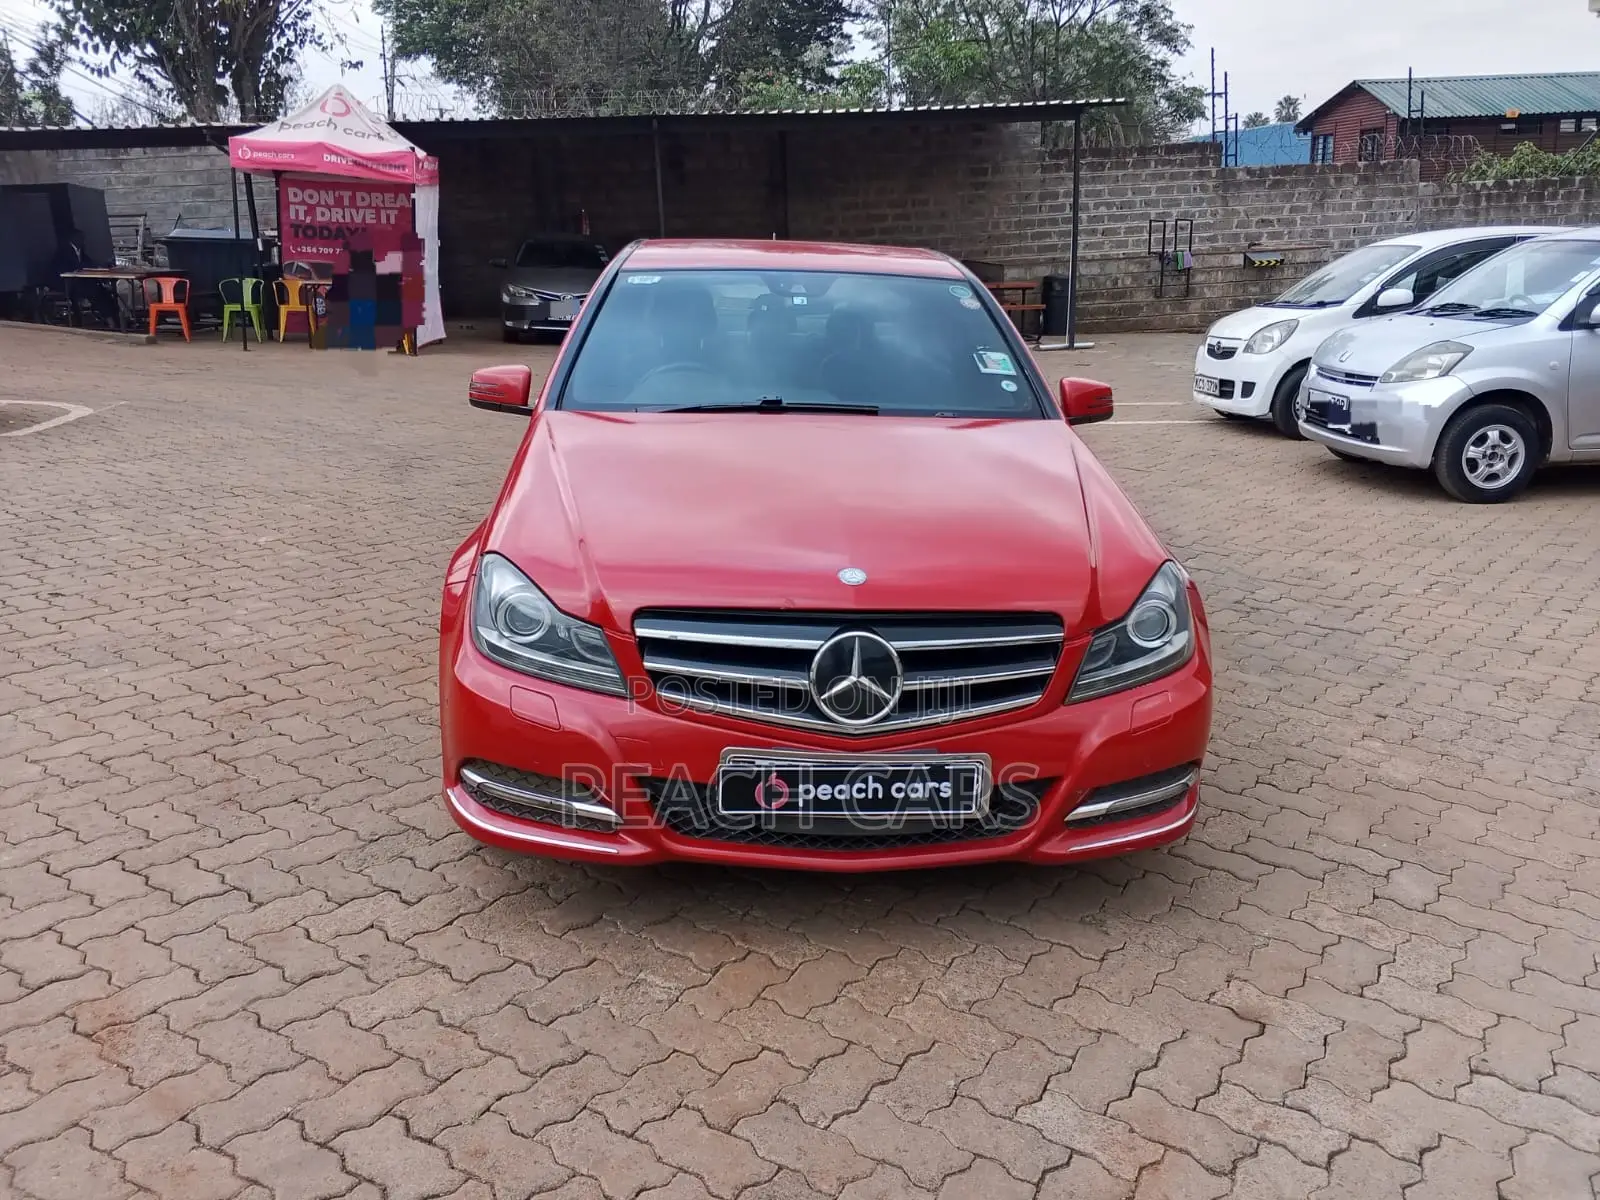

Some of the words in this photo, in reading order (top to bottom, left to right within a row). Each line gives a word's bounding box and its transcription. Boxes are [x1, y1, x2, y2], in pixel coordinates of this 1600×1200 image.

[279, 118, 338, 132] peach
[253, 150, 277, 160] peach
[287, 187, 352, 207] DON'T
[355, 191, 413, 208] DREA
[289, 204, 312, 223] IT,
[316, 206, 377, 224] DRIVE
[380, 209, 399, 225] IT
[798, 775, 883, 807] peach
[890, 780, 952, 799] cars
